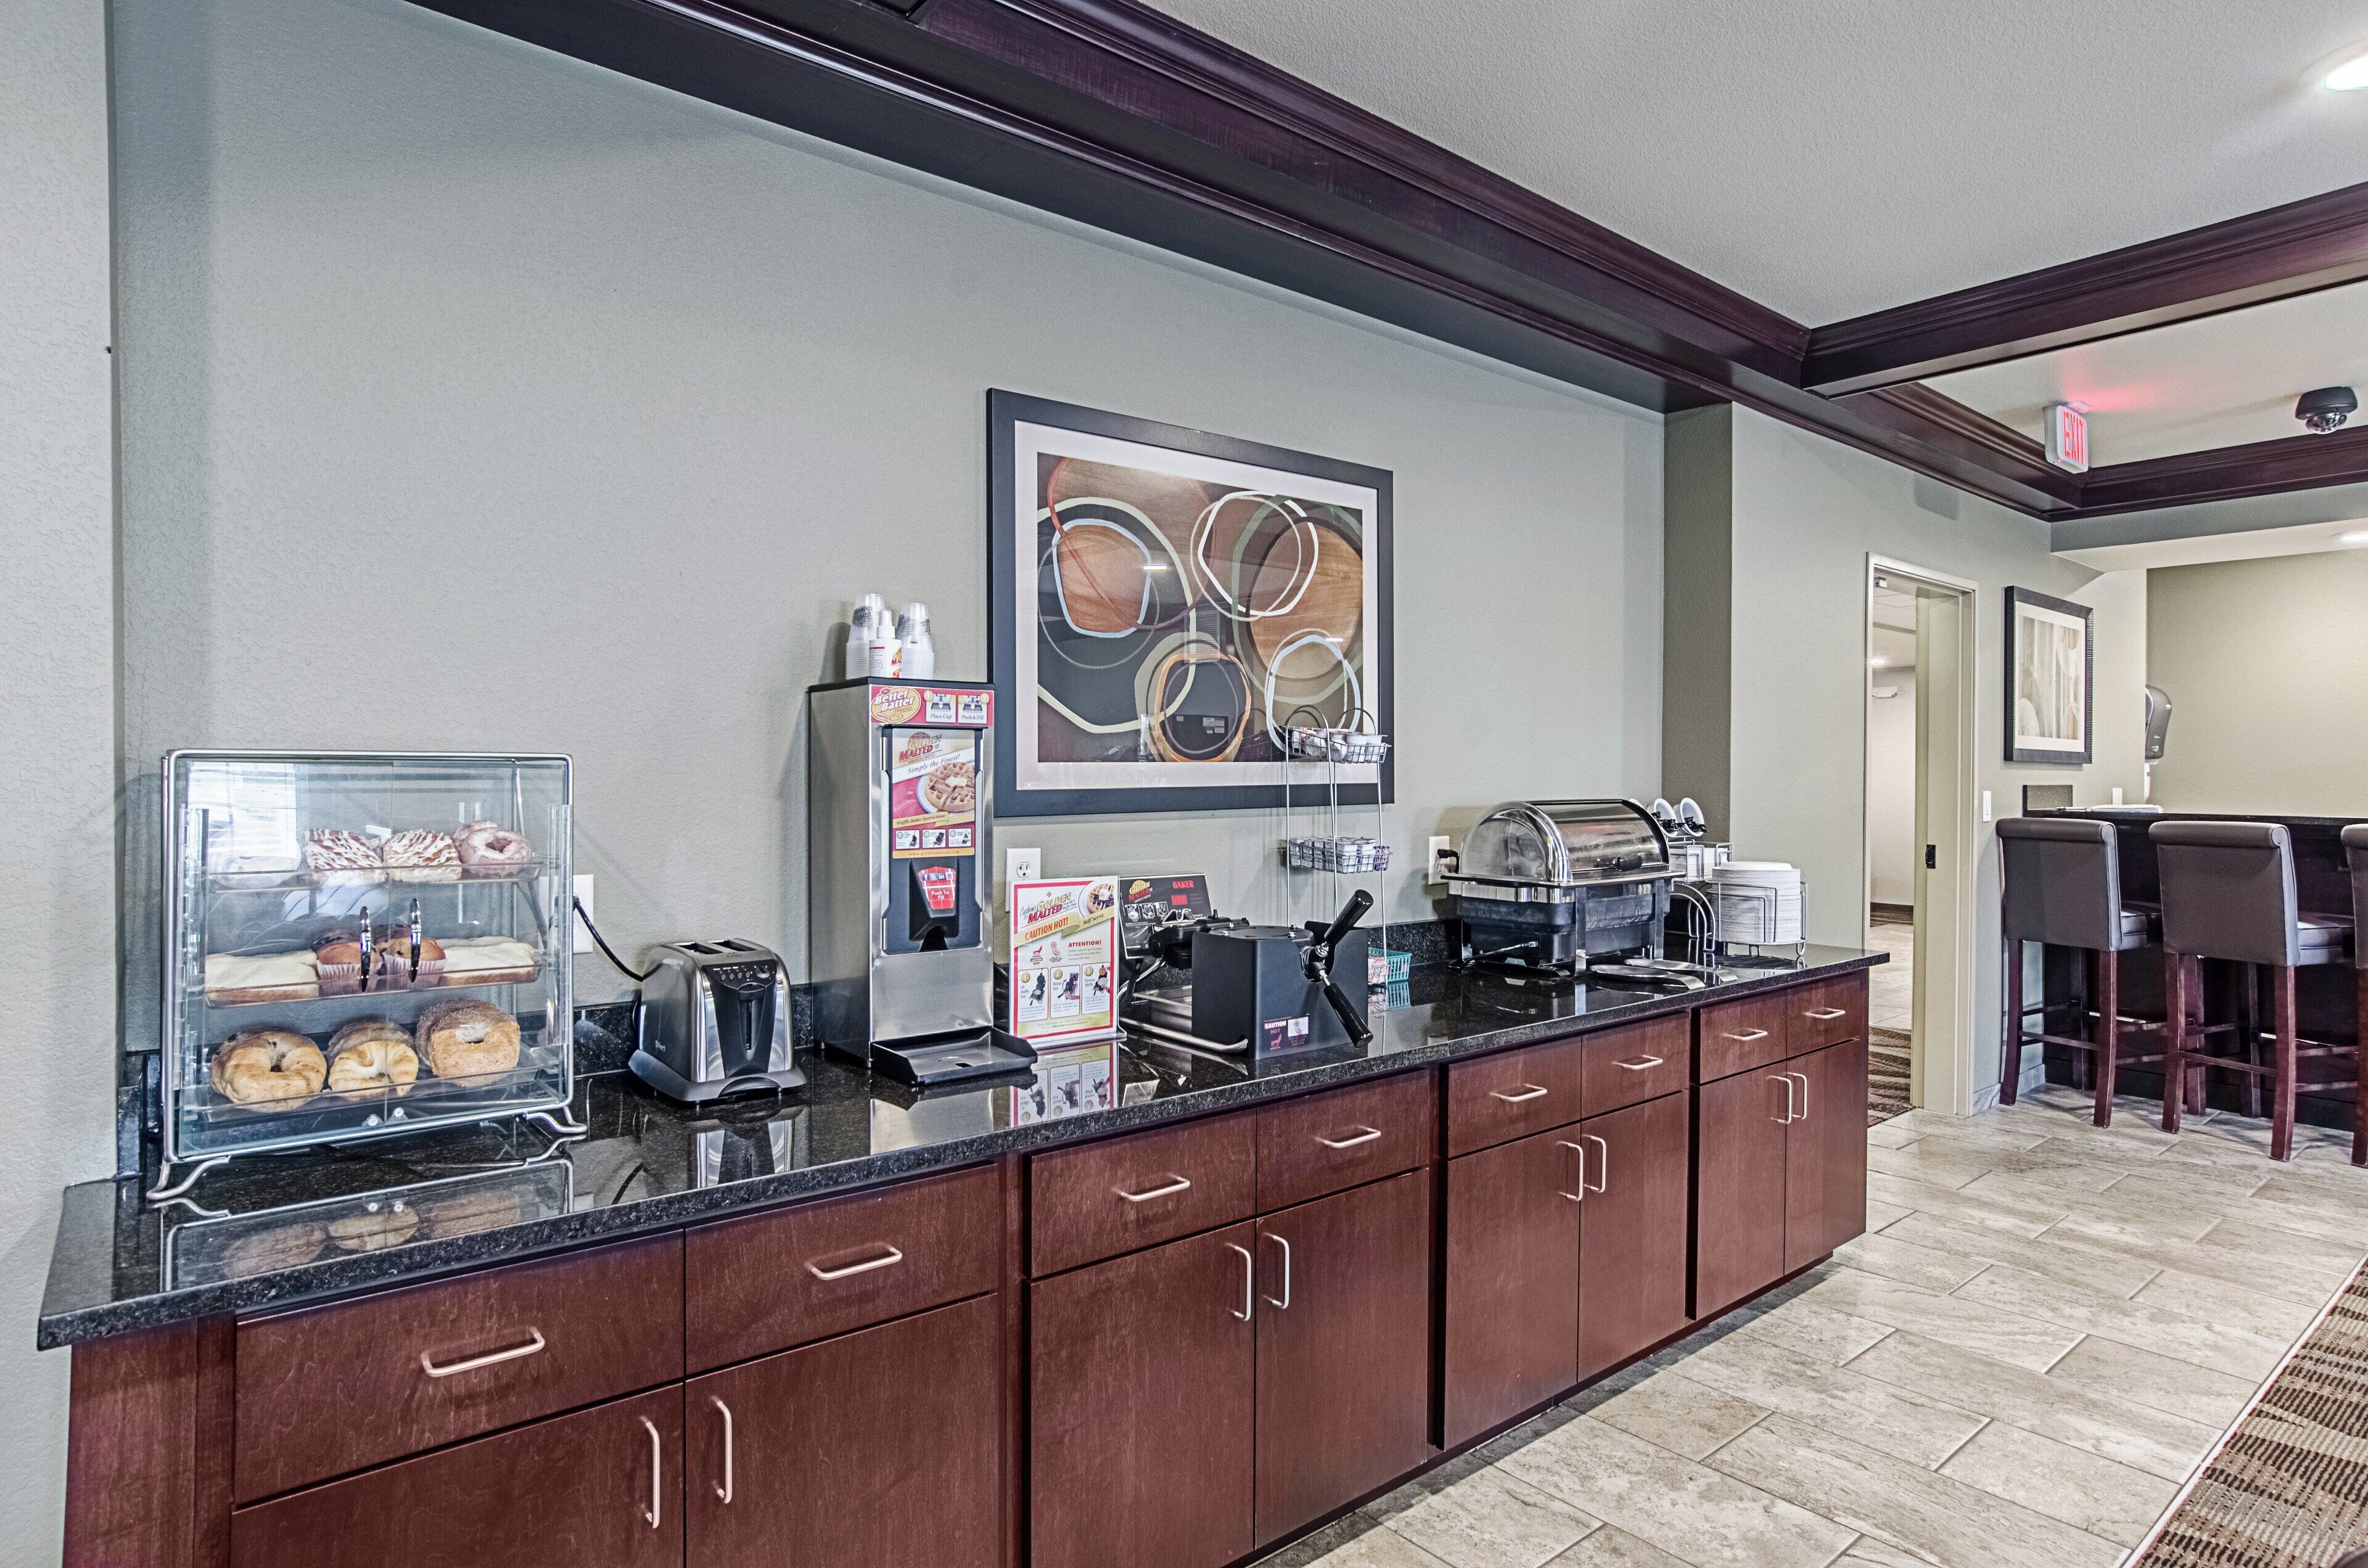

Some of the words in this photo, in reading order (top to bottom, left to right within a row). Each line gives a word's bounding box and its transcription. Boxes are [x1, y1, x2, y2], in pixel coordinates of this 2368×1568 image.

[2063, 411, 2085, 465] EXIT
[874, 689, 910, 705] Better
[881, 696, 915, 712] Batter
[908, 734, 942, 750] GOLDEN
[899, 745, 933, 761] MALTED
[908, 763, 928, 774] Simply
[940, 753, 960, 764] Finest!
[1172, 880, 1194, 889] BAKER
[1037, 892, 1071, 911] GOLDEN
[1028, 904, 1063, 924] MALTED
[1092, 913, 1104, 921] Serve
[1025, 923, 1053, 940] CAUTION
[1054, 916, 1069, 929] HOT!
[1068, 940, 1101, 948] ATTENTION!
[1265, 1020, 1286, 1029] CAUTION
